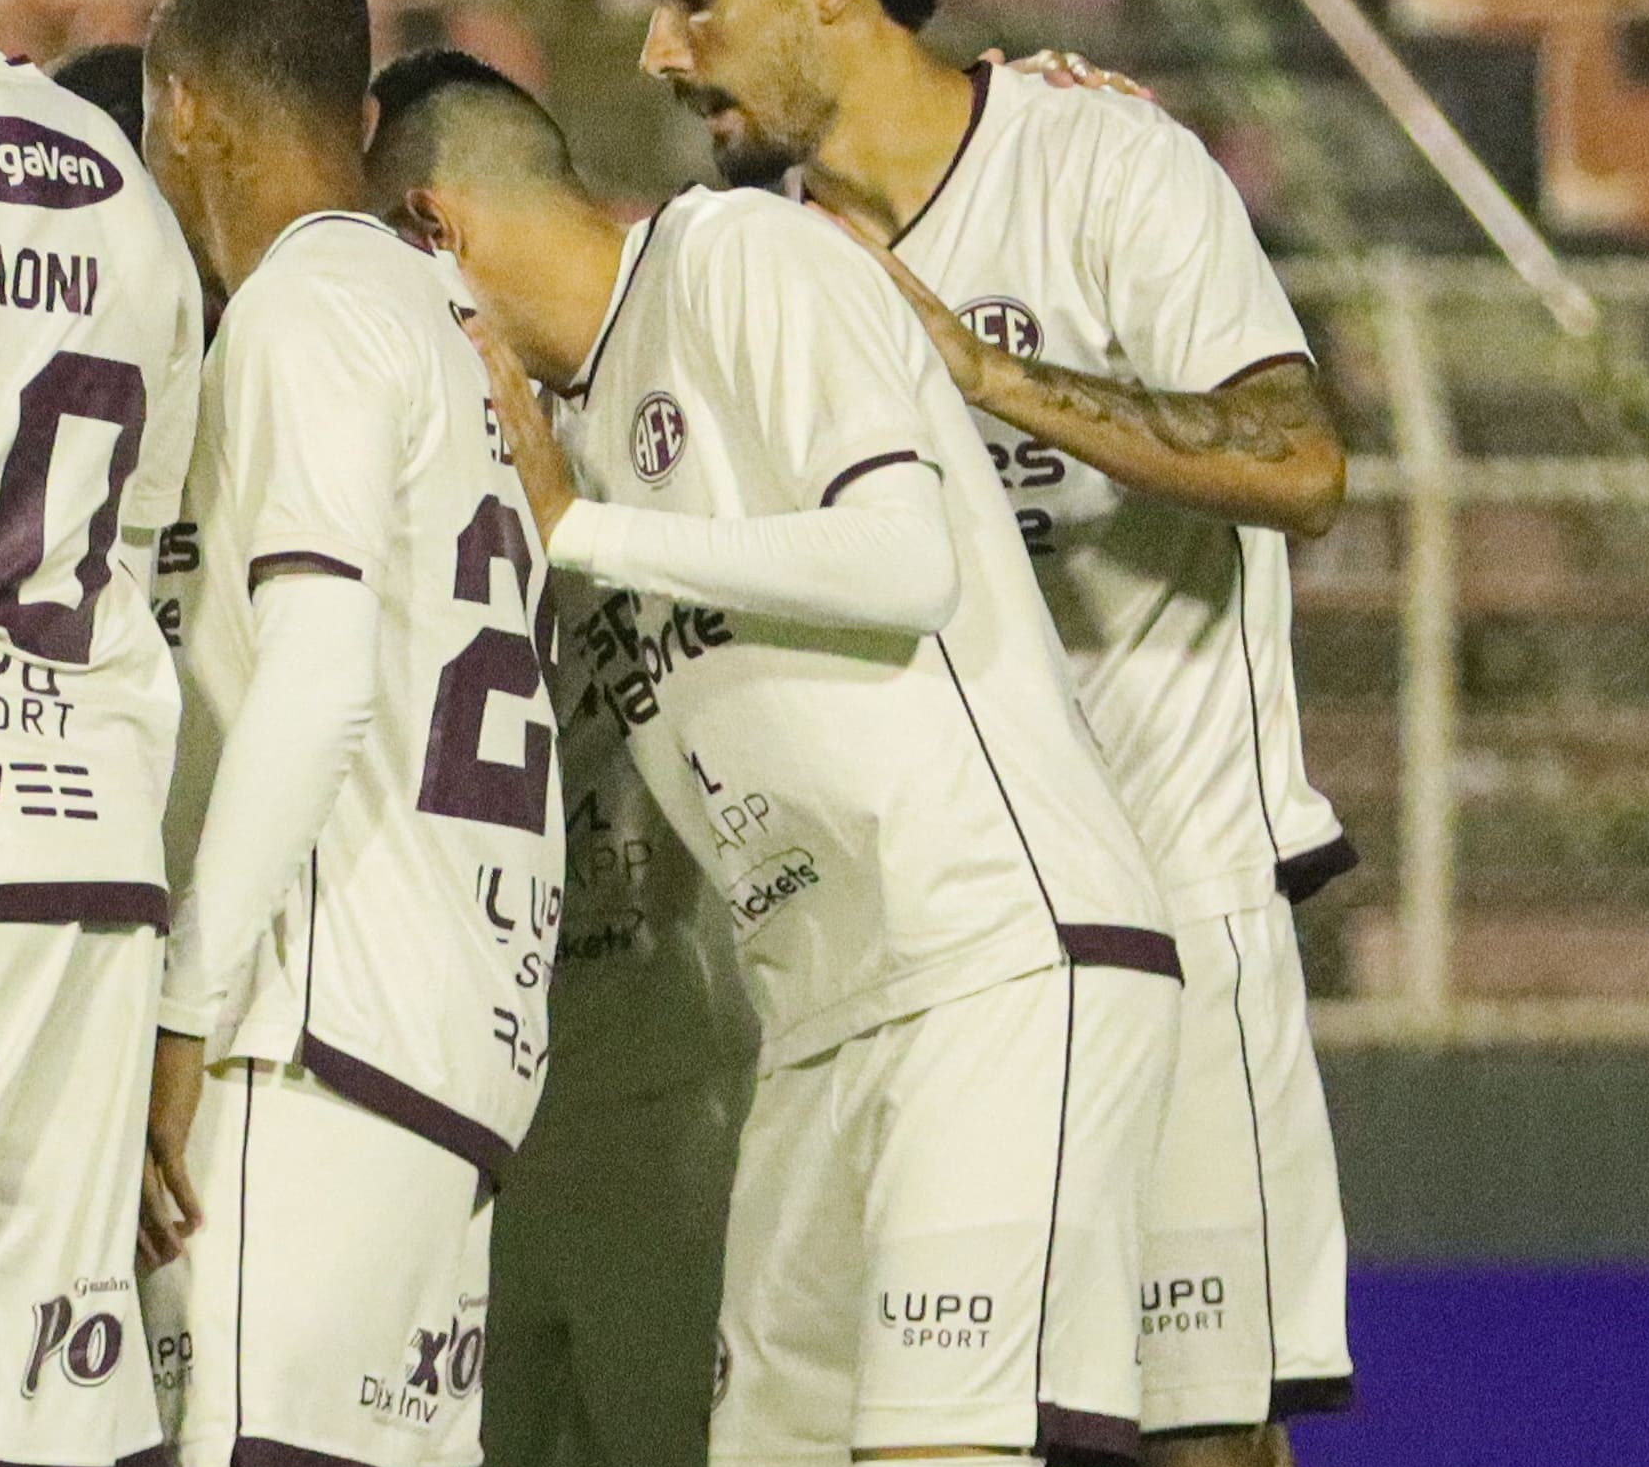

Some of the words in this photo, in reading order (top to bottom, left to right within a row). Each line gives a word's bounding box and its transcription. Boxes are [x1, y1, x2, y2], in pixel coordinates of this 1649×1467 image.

[416, 494, 559, 836] 2
[880, 1291, 994, 1327] LUPO
[1140, 1277, 1225, 1312] UPO
[902, 1328, 991, 1349] SPORT
[360, 1374, 394, 1411] Dix
